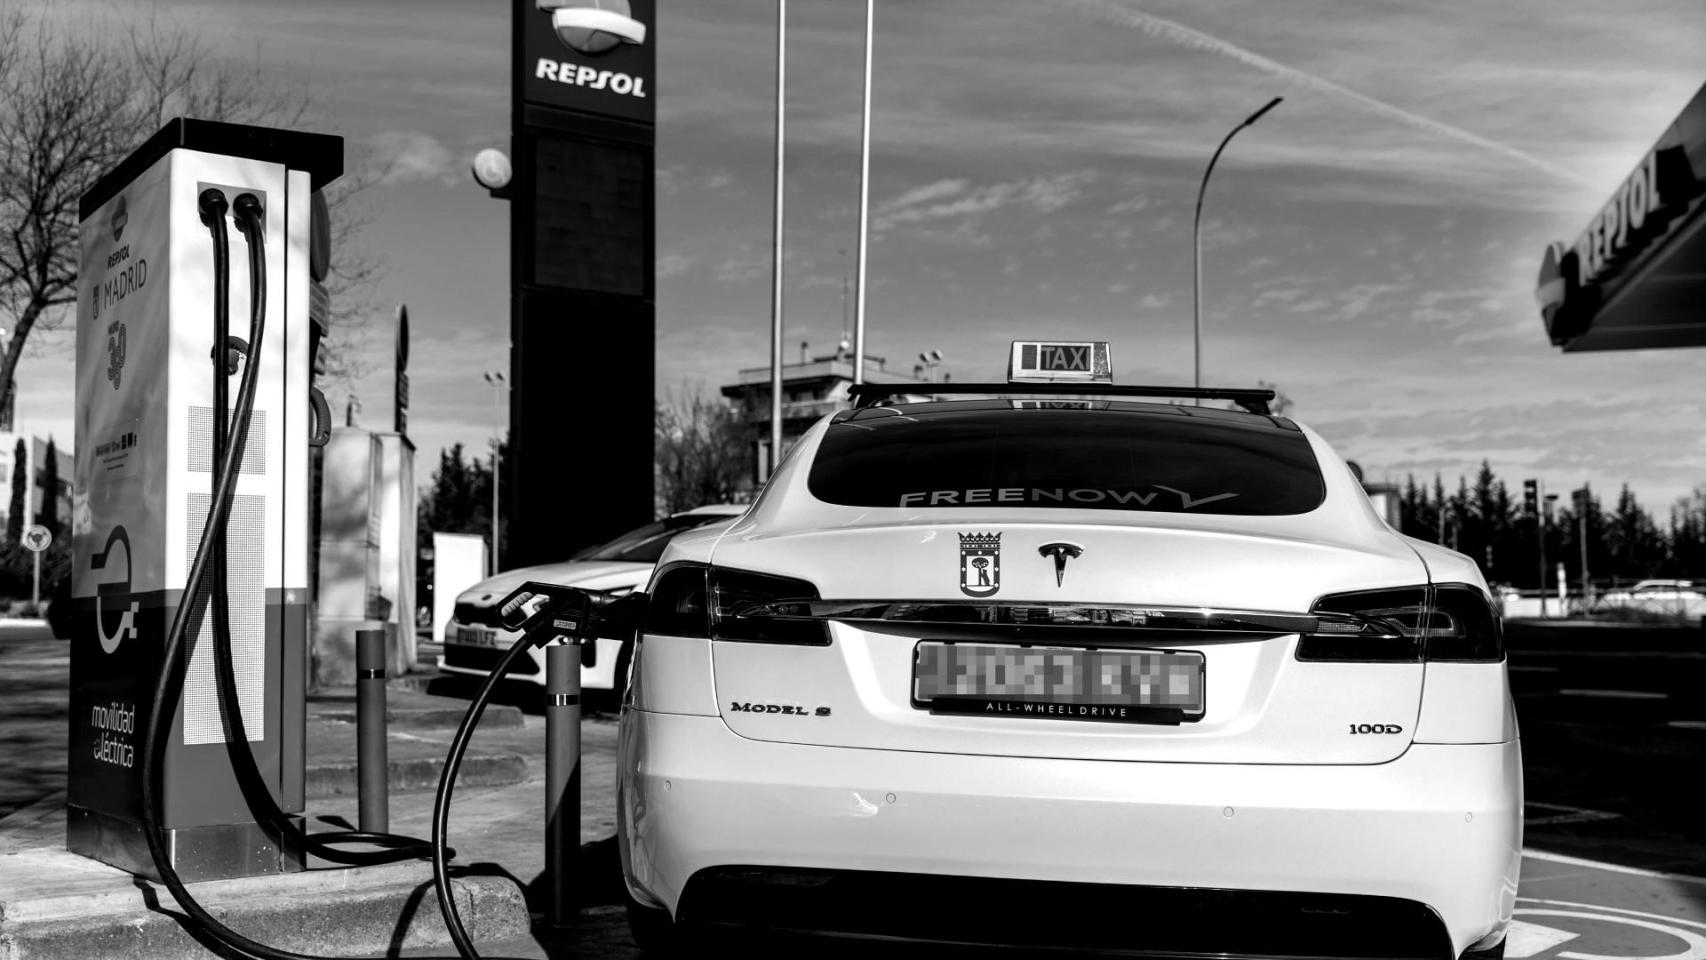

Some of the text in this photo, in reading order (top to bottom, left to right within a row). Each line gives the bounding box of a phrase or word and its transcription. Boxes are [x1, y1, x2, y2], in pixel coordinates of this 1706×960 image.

[535, 58, 646, 98] REPSOL
[1578, 149, 1660, 287] REPSOL
[107, 243, 130, 271] REPSOL
[104, 258, 147, 309] MADRID
[1041, 347, 1090, 370] TAXI
[900, 487, 1158, 509] FREENOW
[92, 701, 135, 735] movilidad
[731, 702, 832, 717] MODEL S
[1349, 724, 1403, 734] 100D
[93, 732, 134, 768] eléctrica
